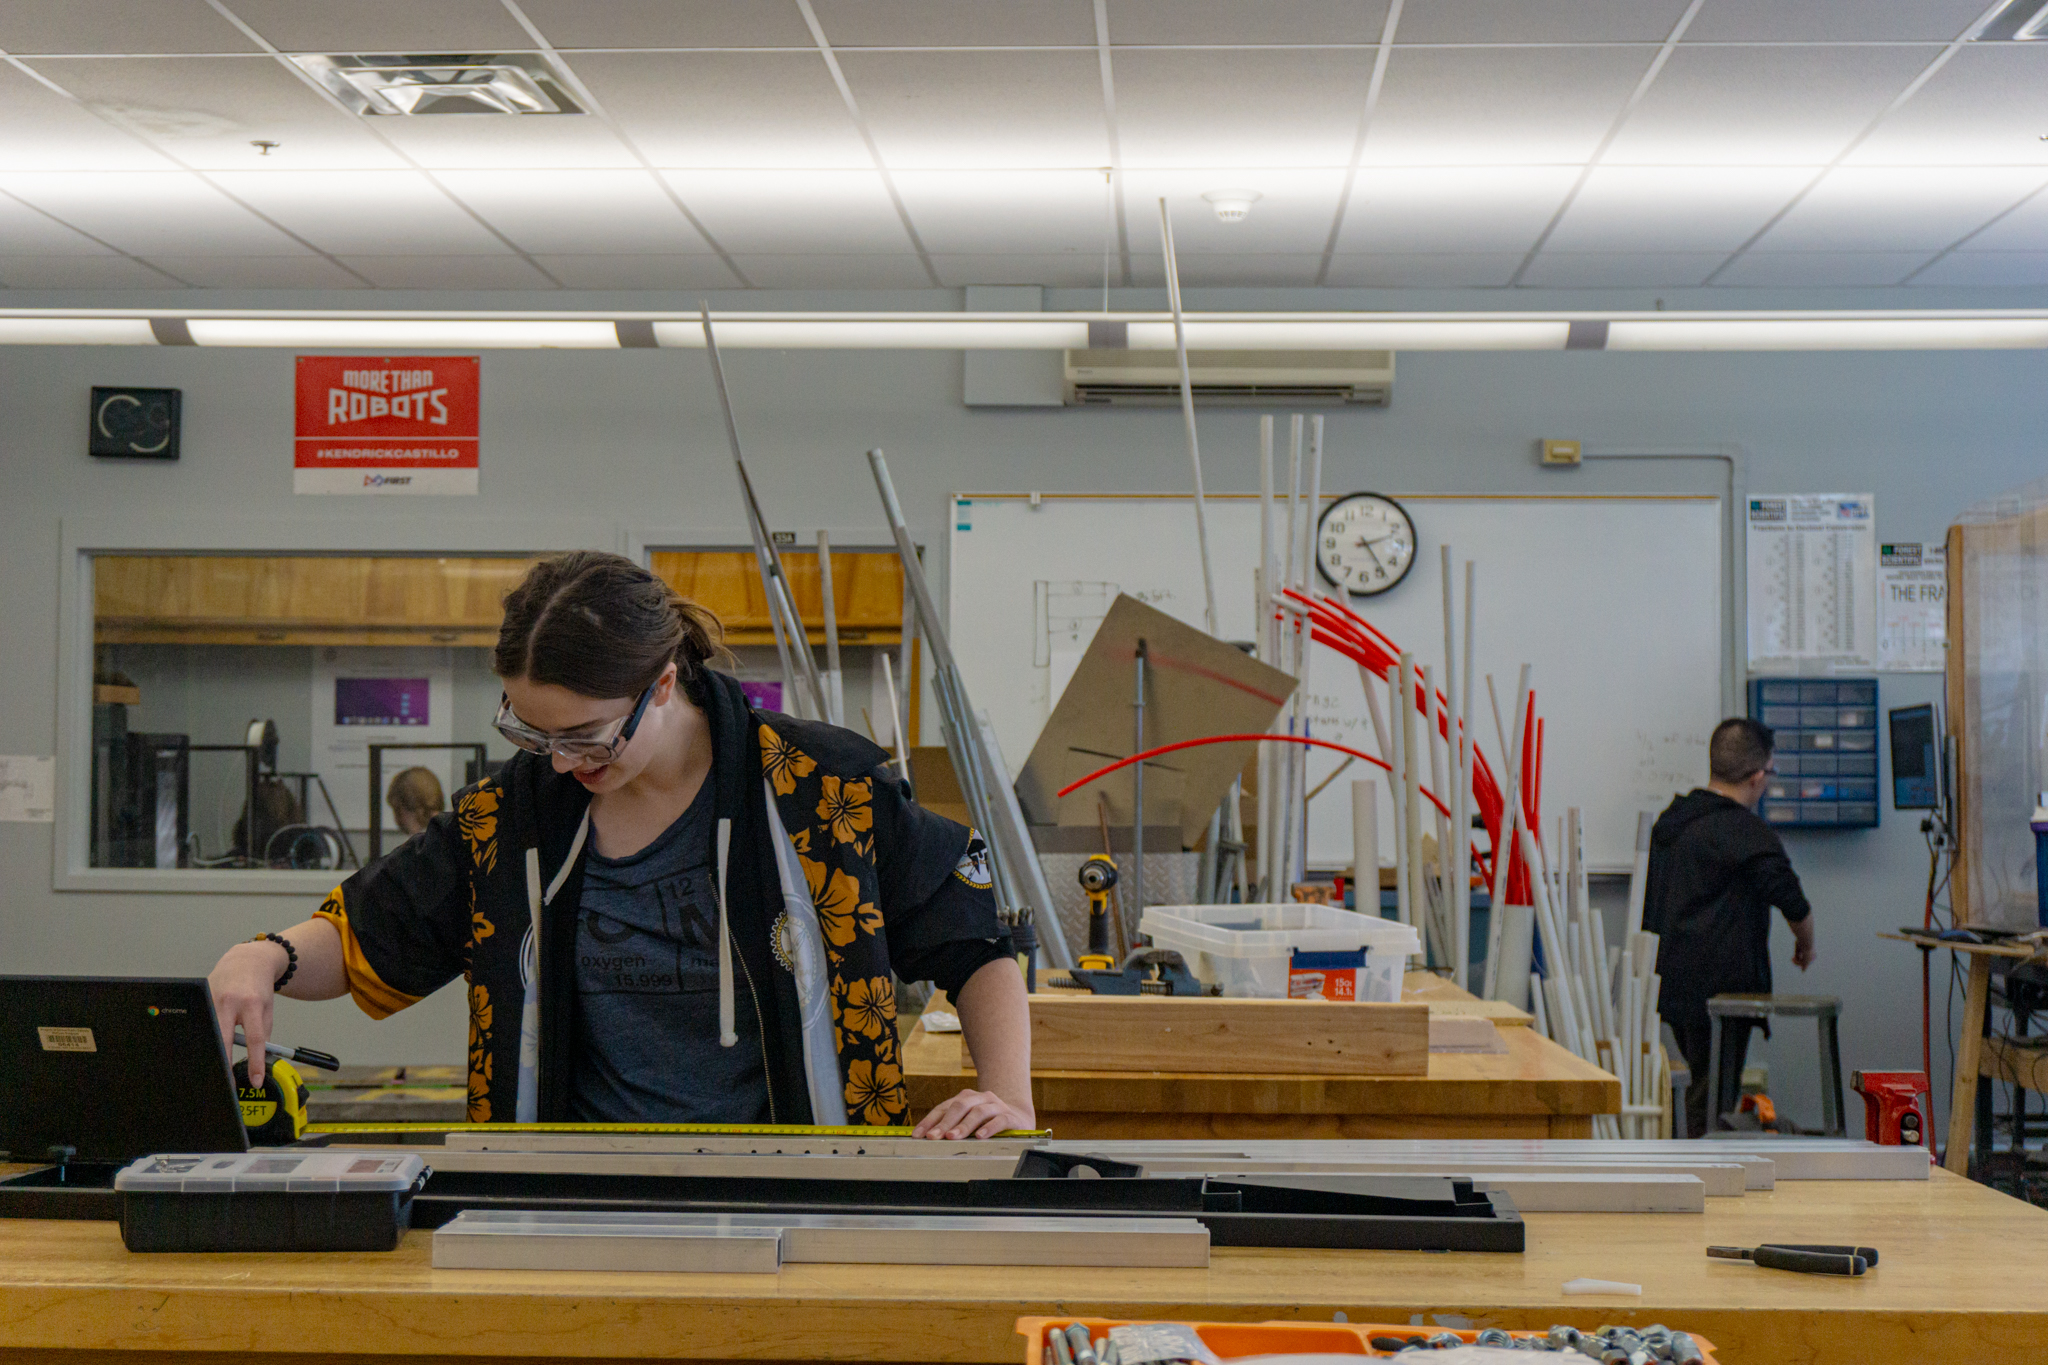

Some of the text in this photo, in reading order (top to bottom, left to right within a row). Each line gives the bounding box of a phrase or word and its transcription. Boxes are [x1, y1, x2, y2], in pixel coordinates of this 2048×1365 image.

[343, 369, 433, 394] MORE THAN
[328, 387, 449, 426] ROBOTS
[317, 448, 459, 459] #KENDRICKCASTILLO
[383, 476, 413, 485] FIRST
[1345, 507, 1355, 521] 11
[1360, 504, 1374, 518] 12
[1330, 521, 1345, 534] 10
[1326, 537, 1336, 549] 9
[1331, 554, 1341, 565] 8
[1388, 555, 1398, 566] 4
[1343, 565, 1353, 577] 7
[1359, 570, 1369, 583] 6
[1890, 584, 1916, 603] THE
[664, 876, 696, 900] 12
[581, 955, 646, 971] oxygen
[616, 973, 673, 987] 15.999
[160, 1007, 188, 1015] chrome
[238, 1087, 267, 1099] 7.5M
